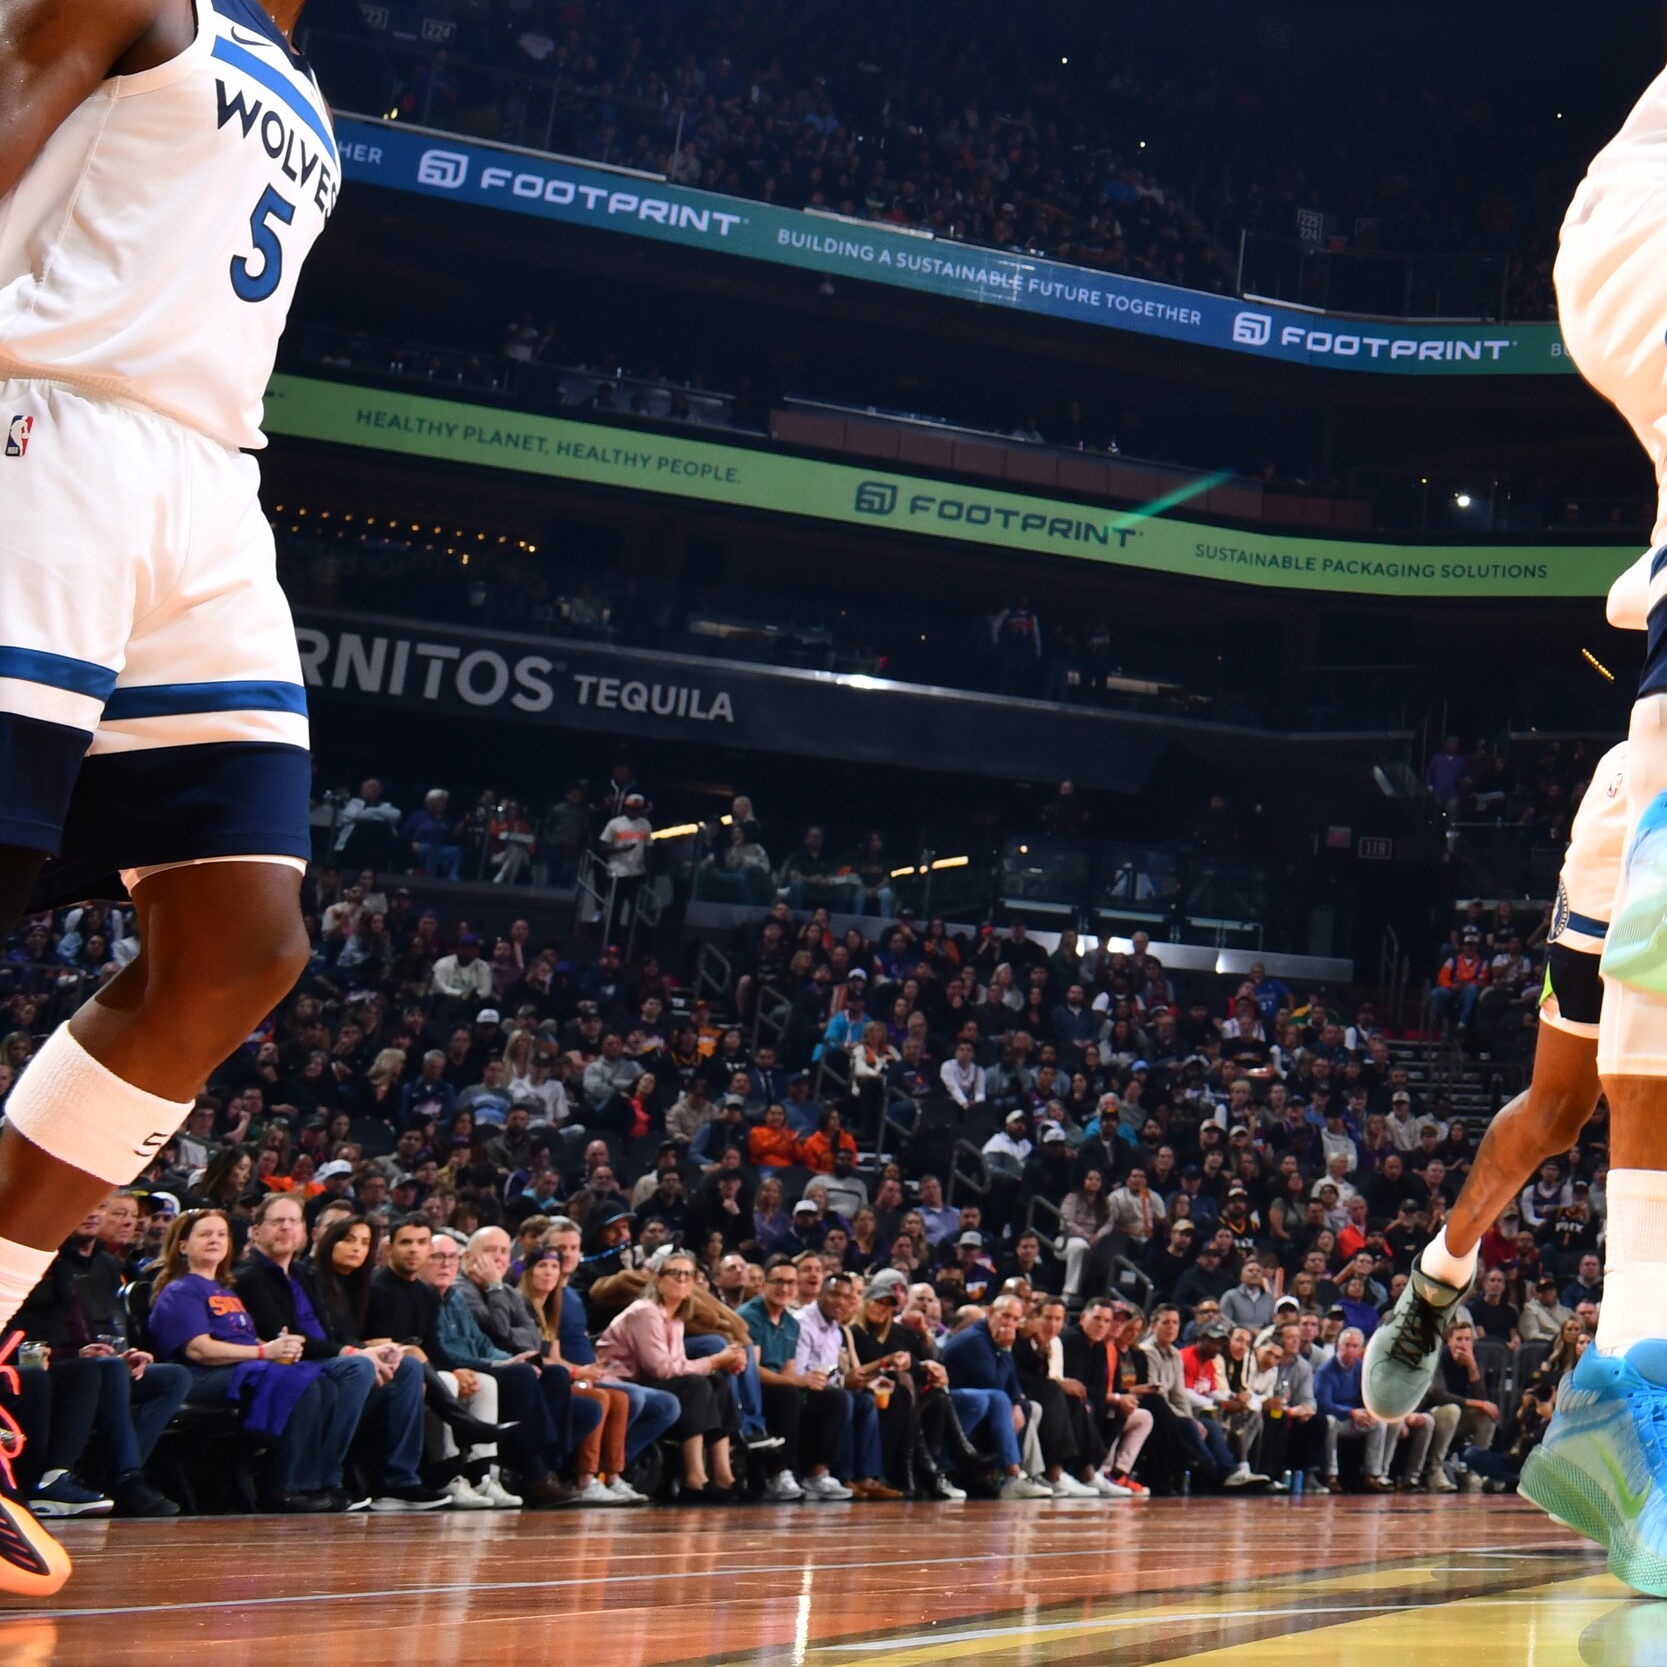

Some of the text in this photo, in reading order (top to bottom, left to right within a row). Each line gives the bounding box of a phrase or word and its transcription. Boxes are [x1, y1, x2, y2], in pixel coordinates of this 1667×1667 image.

[480, 167, 742, 237] FOOTPRINT
[229, 183, 296, 304] 5
[778, 228, 1202, 326] BUILDING A SUSTAINABLE FUTURE TOGETHER
[1281, 327, 1510, 360] FOOTPRINT
[357, 409, 742, 484] HEALTHY HEALTHY PEOPLE.
[909, 495, 1136, 548] FOOTPRINT
[1195, 543, 1548, 579] SUSTAINABLE PACKAGING SOLUTIONS
[297, 627, 735, 723] RNITOS TEQUILA
